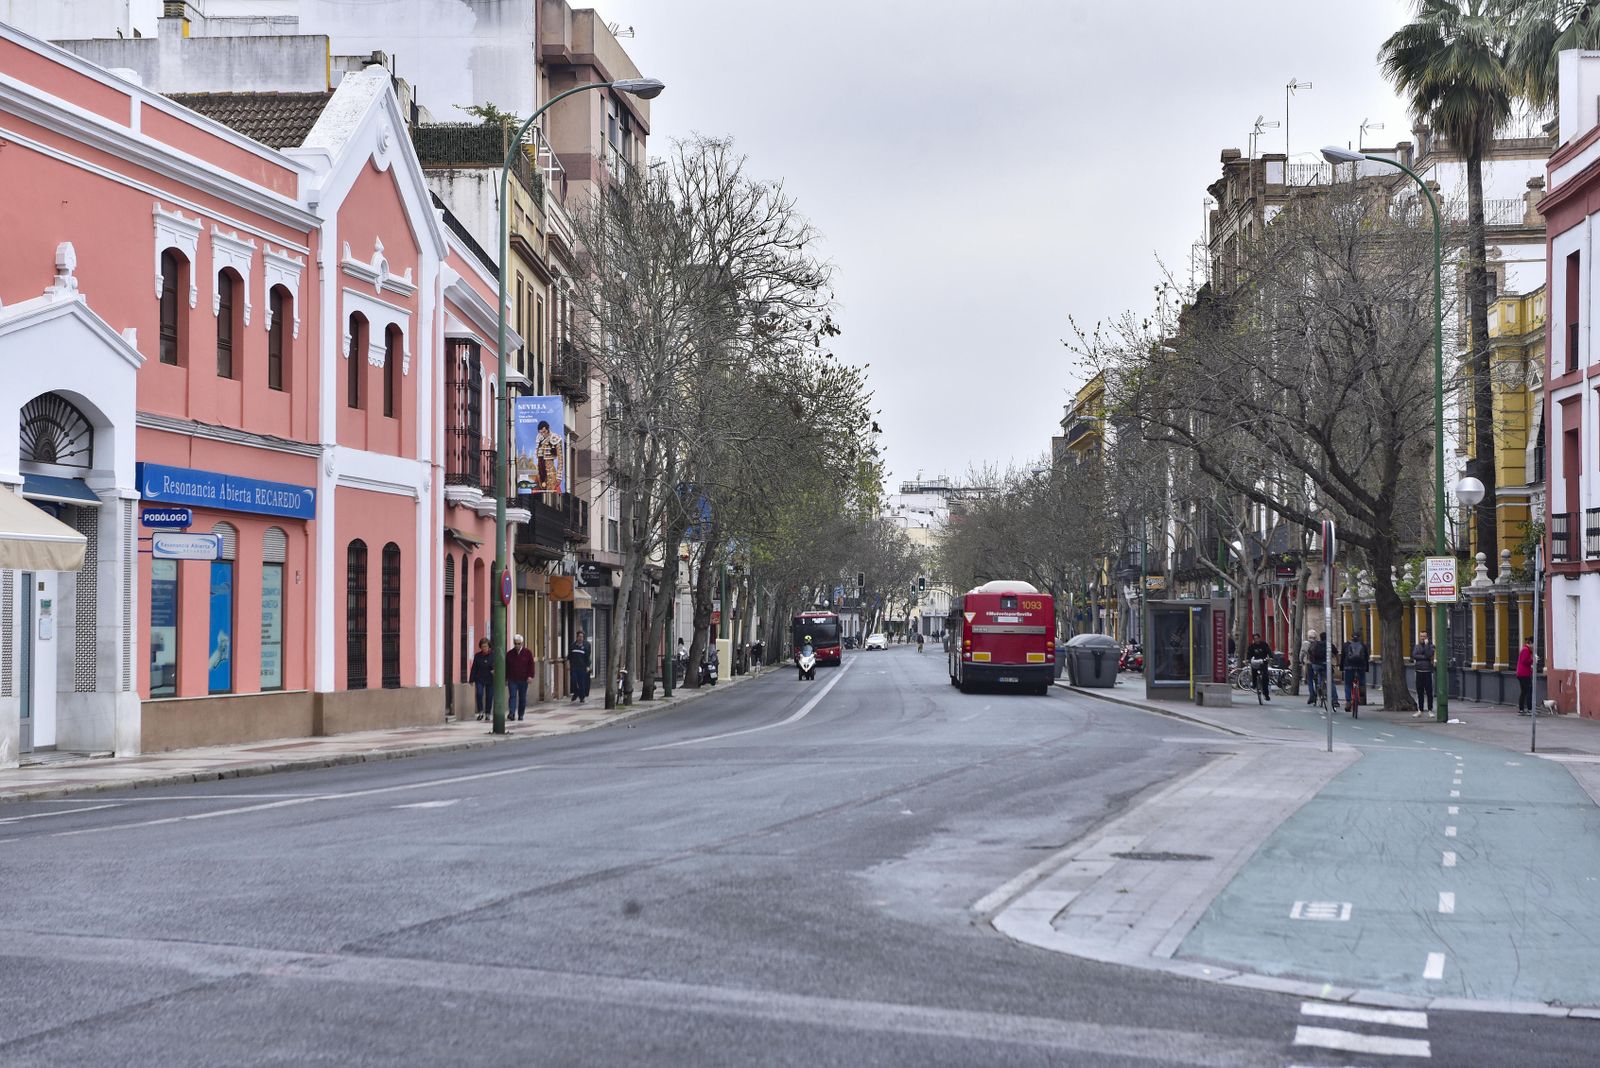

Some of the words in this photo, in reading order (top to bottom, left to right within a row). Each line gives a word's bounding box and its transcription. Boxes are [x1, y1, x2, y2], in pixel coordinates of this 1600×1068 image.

[163, 475, 216, 499] Resonancia
[219, 483, 252, 504] Abierta
[255, 488, 301, 510] RECAREDO
[144, 511, 188, 522] PODÓLOGO
[160, 541, 189, 549] Resonancia
[1022, 601, 1042, 610] 1093
